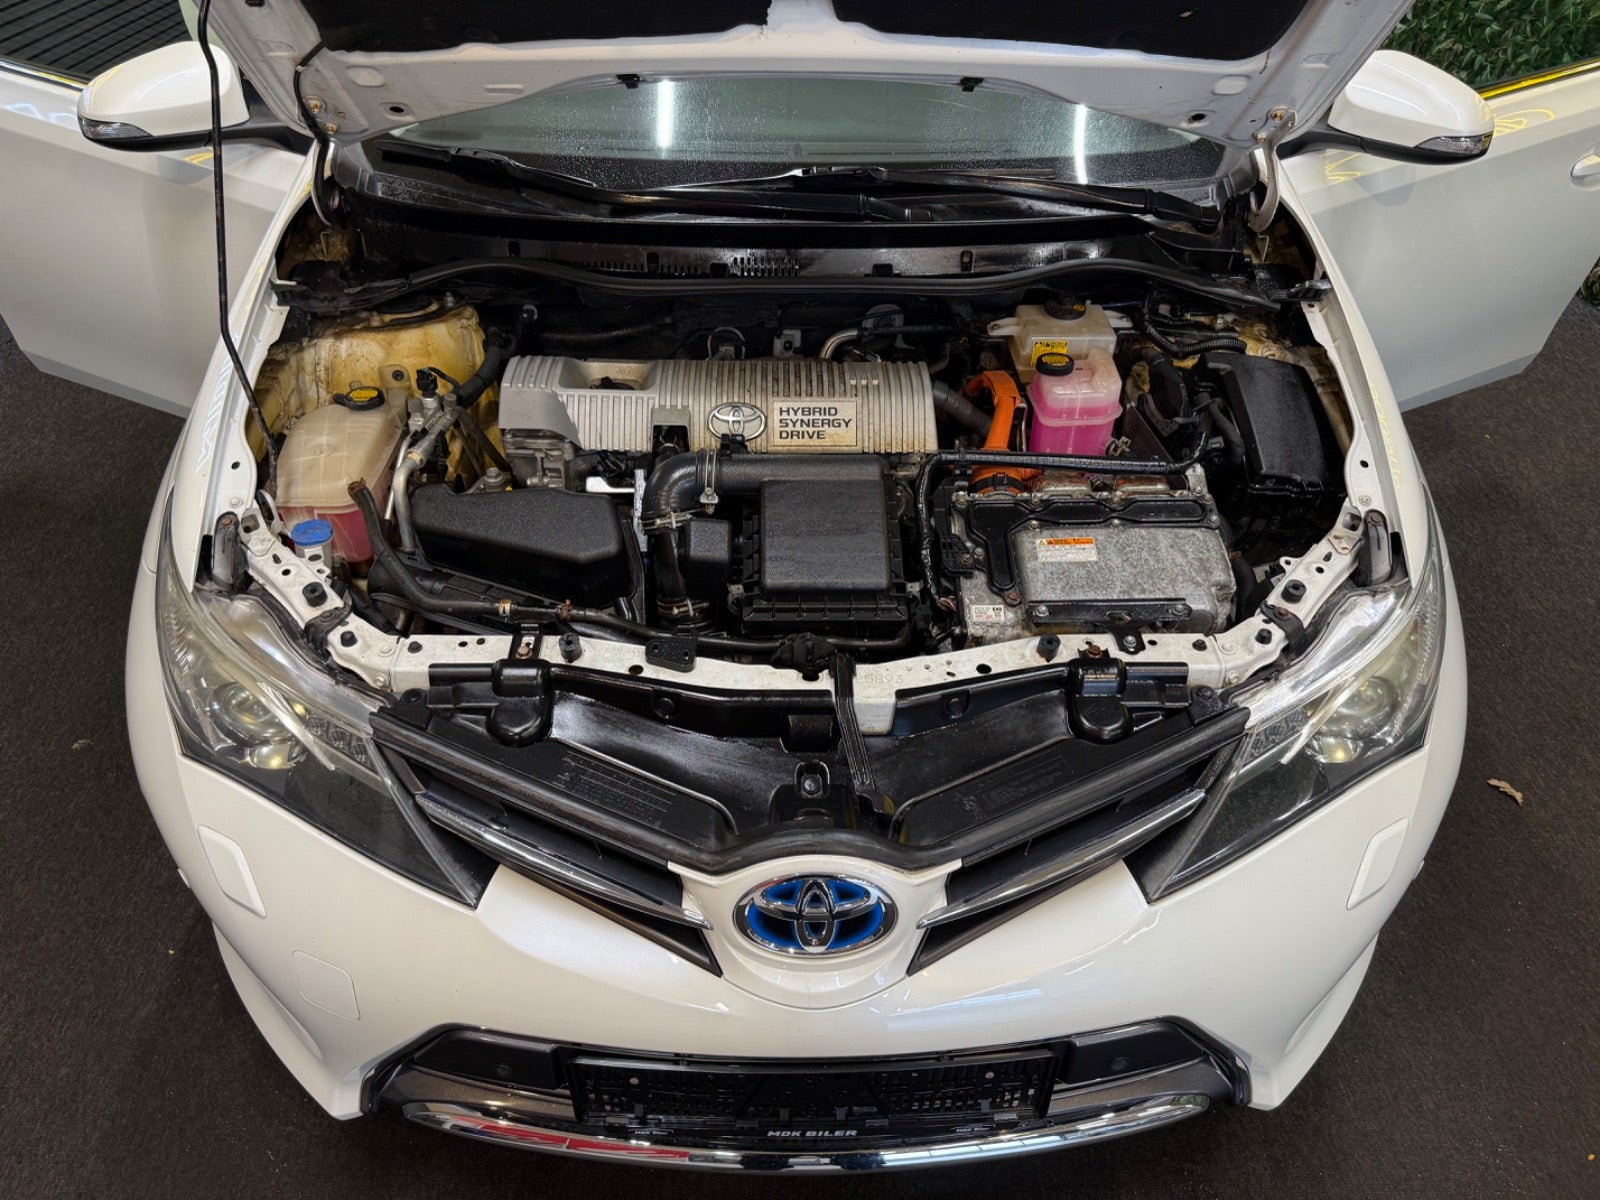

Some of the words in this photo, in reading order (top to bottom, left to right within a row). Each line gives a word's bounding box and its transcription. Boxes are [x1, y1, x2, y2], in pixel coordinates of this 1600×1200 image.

[779, 406, 838, 417] HYBRID
[779, 418, 852, 428] SYNERGY
[779, 430, 826, 440] DRIVE
